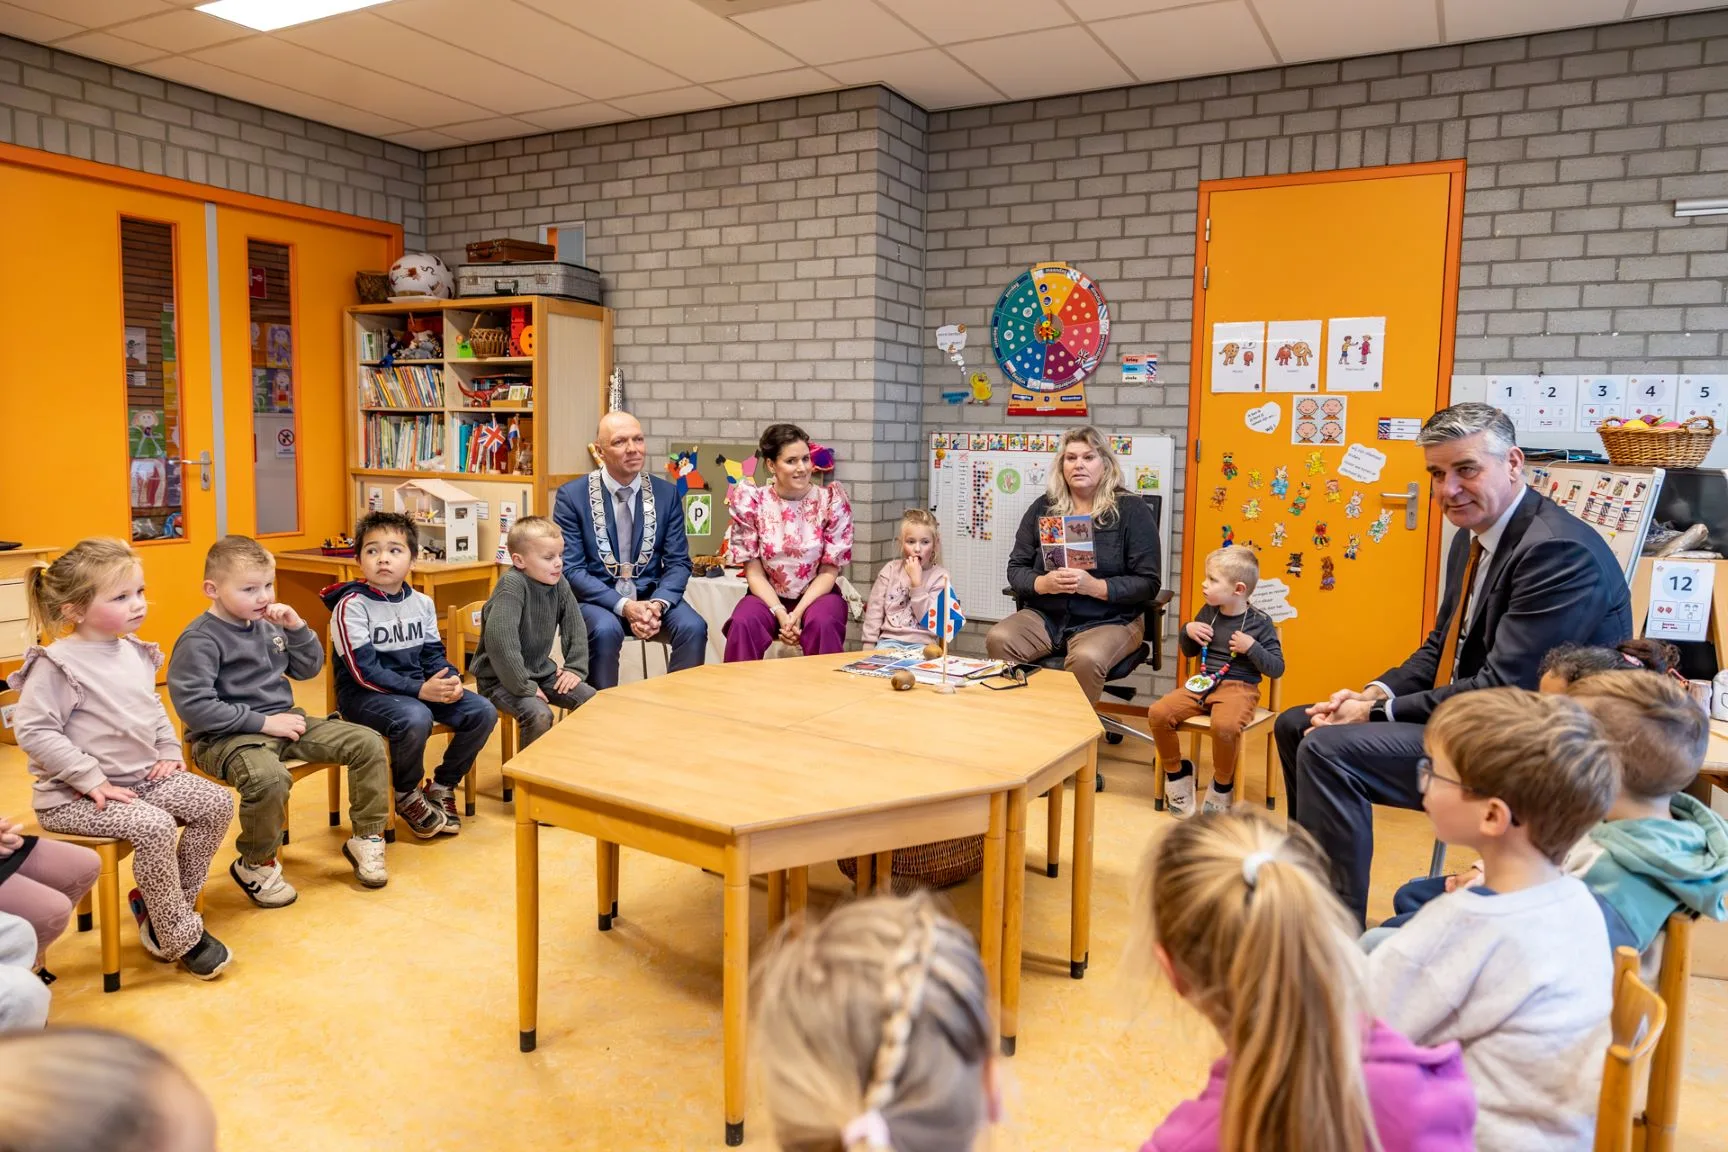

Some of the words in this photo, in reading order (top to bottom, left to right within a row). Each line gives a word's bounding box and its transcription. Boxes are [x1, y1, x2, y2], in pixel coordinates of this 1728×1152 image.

[1505, 386, 1513, 398] 1
[1547, 386, 1557, 398] 2
[1598, 385, 1608, 397] 3
[1646, 385, 1656, 397] 4
[1700, 386, 1710, 398] 5
[695, 507, 703, 521] p
[1670, 576, 1693, 591] 12
